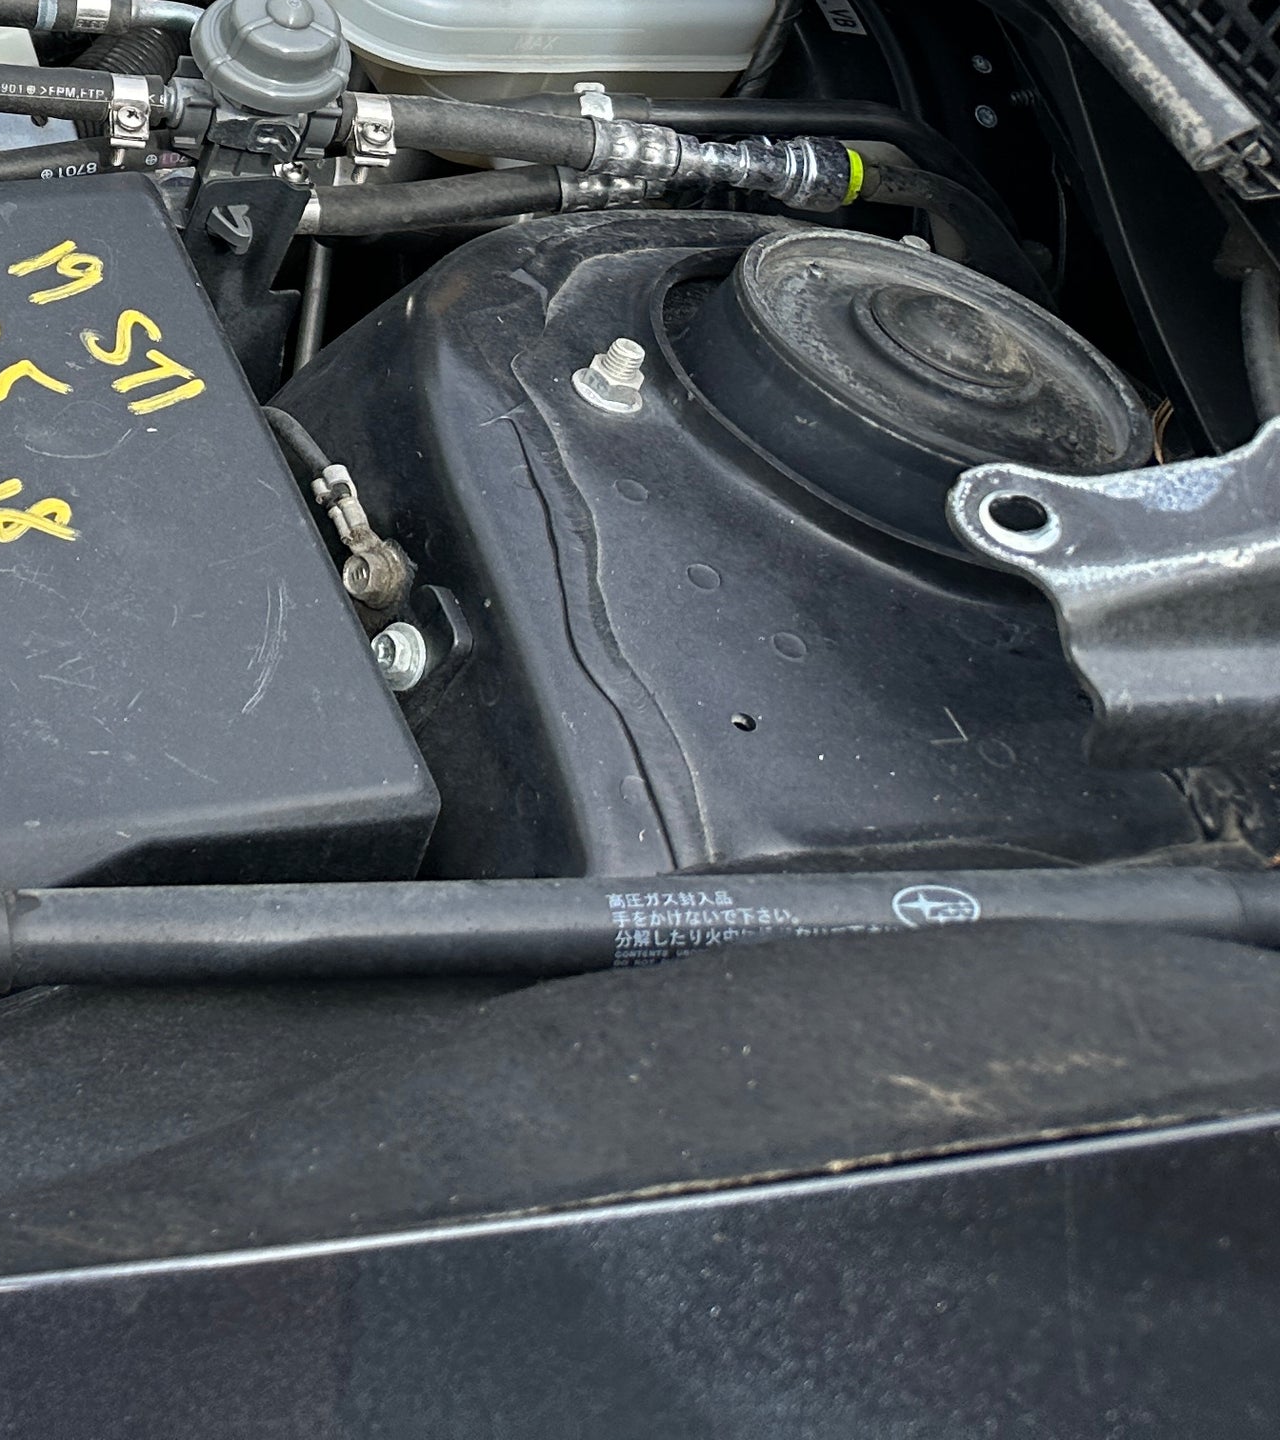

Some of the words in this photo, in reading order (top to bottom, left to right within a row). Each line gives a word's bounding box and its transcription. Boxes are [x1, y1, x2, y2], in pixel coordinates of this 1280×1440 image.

[58, 162, 97, 179] 8701
[7, 239, 104, 305] 19
[80, 309, 207, 416] STI
[606, 891, 734, 908] 高圧ガス封入品
[611, 908, 800, 928] 手をかけないで下さい。
